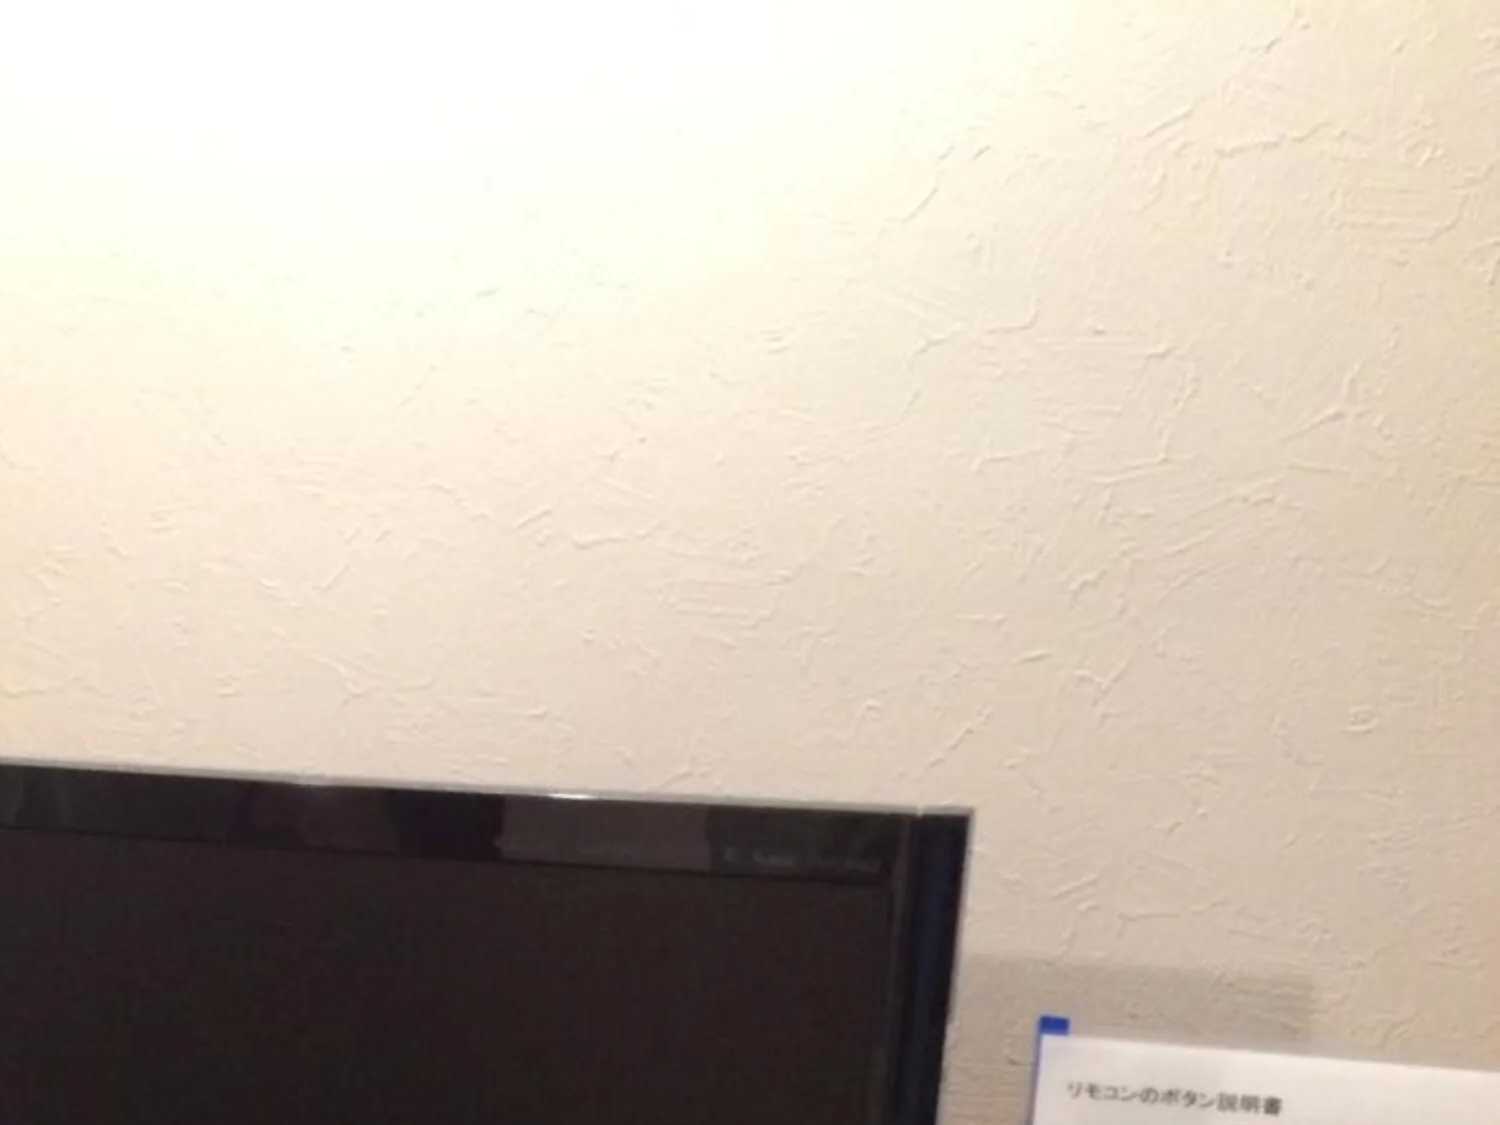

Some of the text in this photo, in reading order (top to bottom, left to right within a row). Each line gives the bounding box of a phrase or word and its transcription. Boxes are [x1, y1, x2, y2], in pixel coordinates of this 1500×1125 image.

[1066, 1082, 1283, 1115] リモコンのボタン説明書
